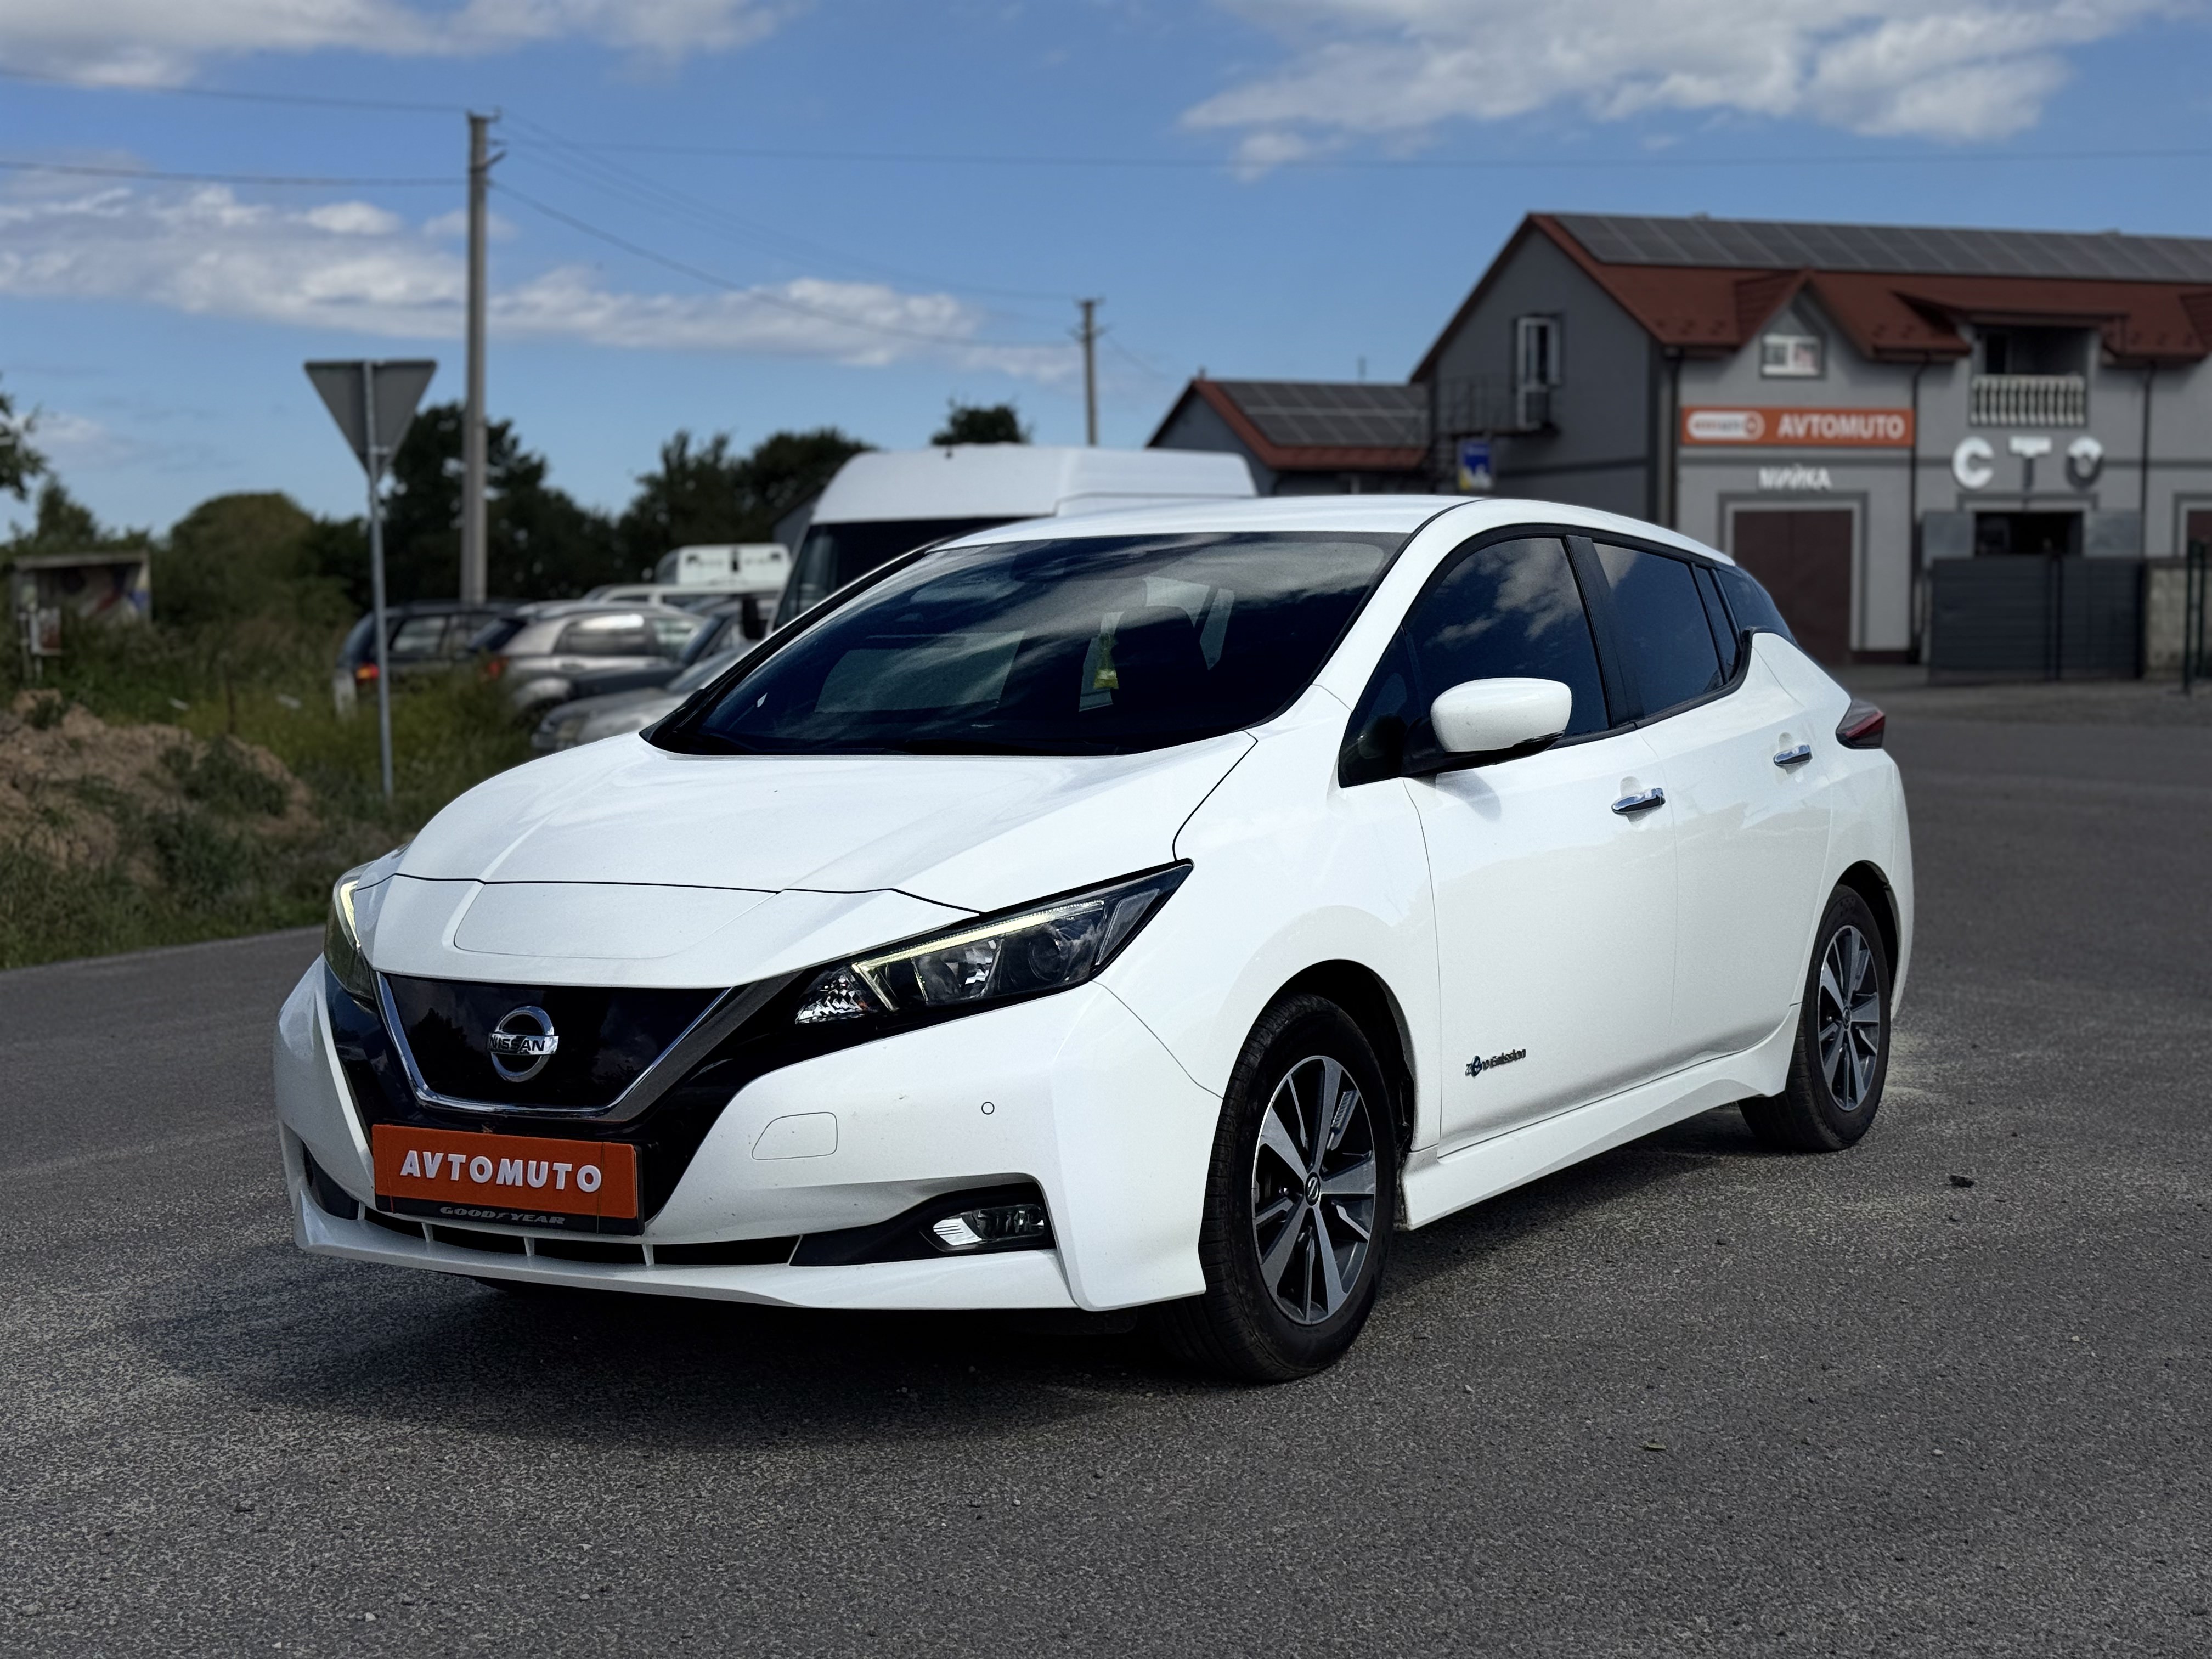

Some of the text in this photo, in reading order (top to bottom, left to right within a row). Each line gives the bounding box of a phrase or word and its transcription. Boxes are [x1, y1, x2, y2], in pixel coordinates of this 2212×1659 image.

[1777, 414, 1905, 439] AVTOMUTO
[489, 1035, 545, 1051] NISSAN
[400, 1150, 601, 1193] AVTOMUTO
